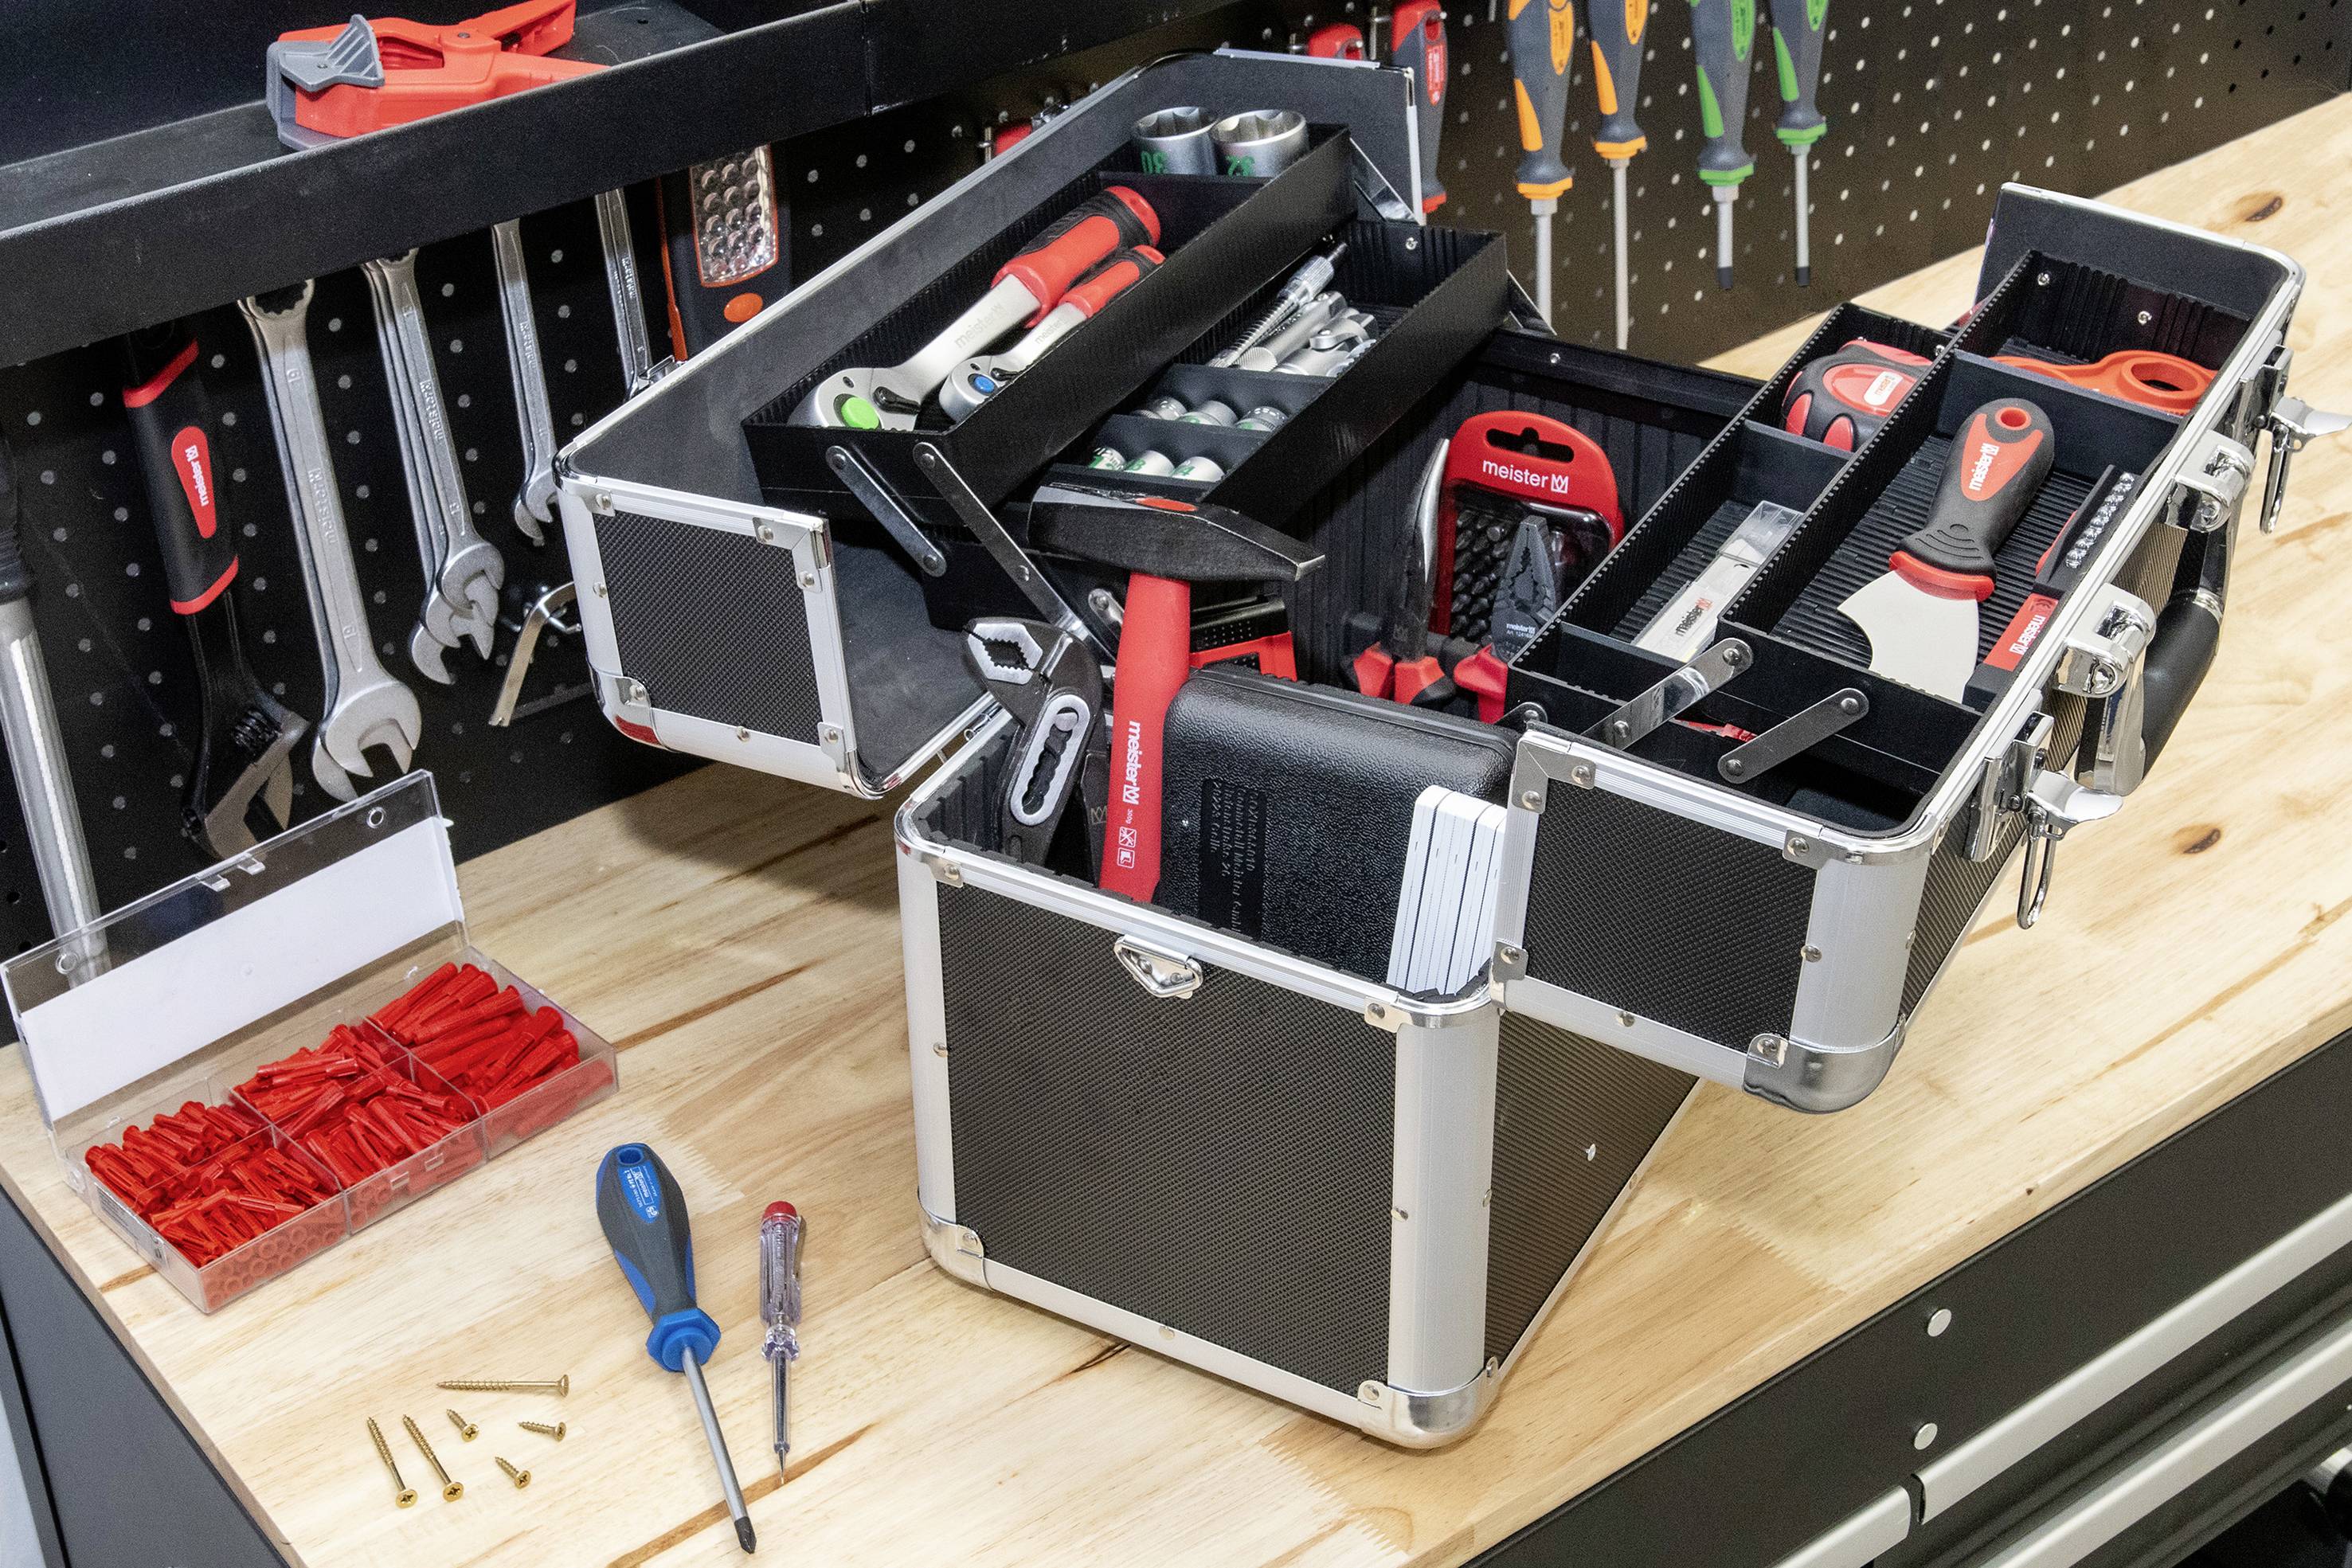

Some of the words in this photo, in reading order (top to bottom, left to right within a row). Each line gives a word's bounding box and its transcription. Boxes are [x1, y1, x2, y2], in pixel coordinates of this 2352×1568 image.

[190, 460, 209, 507] meister
[1482, 459, 1549, 488] meister
[1969, 452, 1994, 491] meister
[1674, 605, 1704, 636] meister
[2017, 613, 2047, 647] meister
[1125, 720, 1143, 786] meister
